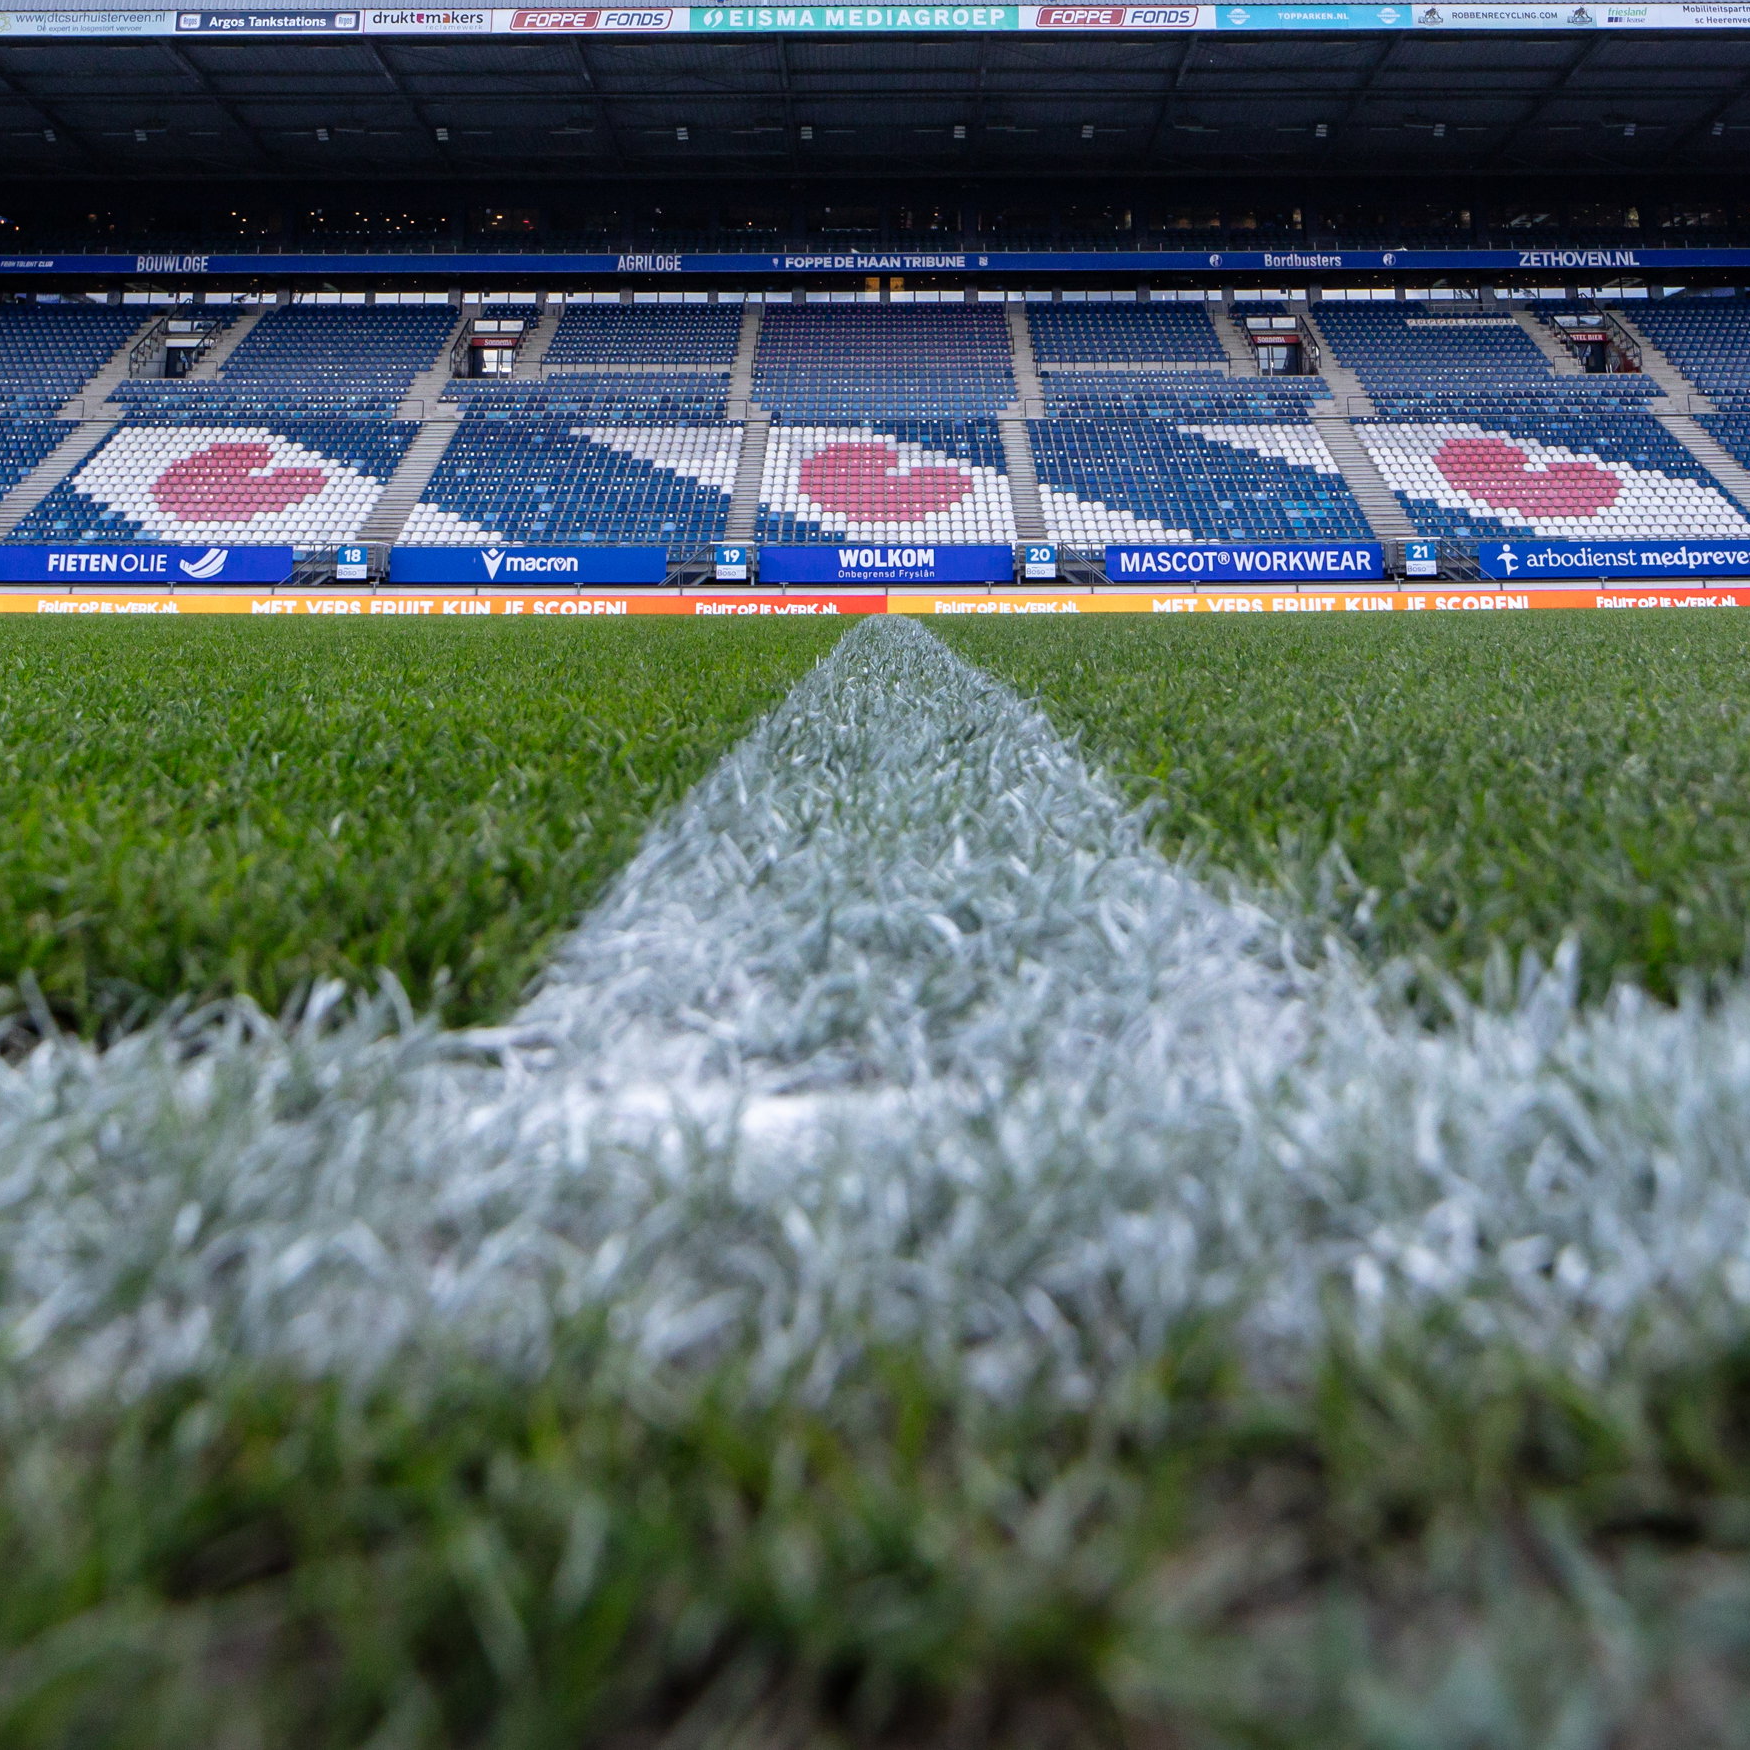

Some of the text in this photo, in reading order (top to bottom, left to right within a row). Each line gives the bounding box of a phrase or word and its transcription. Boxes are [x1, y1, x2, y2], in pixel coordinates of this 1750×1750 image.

[15, 11, 165, 24] www.dtcsurhuisterveen.nl
[730, 9, 1005, 26] EISMA MEDIAGROEP
[1050, 10, 1190, 24] FOPPE FONDS
[1278, 12, 1349, 20] TOPPARKEN.NL
[1452, 11, 1558, 19] ROBBENRECYCLING.COM
[1608, 7, 1647, 16] friesland
[209, 15, 326, 29] Argos Tankstations
[523, 13, 664, 27] FOPPE FONDS
[136, 256, 209, 272] BOUWLOGE
[617, 255, 682, 271] AGRILOGE
[785, 256, 965, 268] FOPPE DE HAAN TRIBUNE
[1264, 253, 1342, 267] Bordbusters
[1519, 251, 1640, 266] ZETHOVEN.NL
[344, 549, 361, 562] 18
[723, 549, 740, 563] 19
[839, 549, 934, 567] WOLKOM
[1030, 548, 1050, 561] 20
[1413, 545, 1428, 558] 21
[1527, 548, 1637, 568] arbodienst
[48, 554, 167, 572] FIETEN OLIE
[506, 555, 578, 572] macron
[1233, 551, 1371, 572] WORKWEAR
[838, 568, 935, 579] Onbegrensd Fryslân
